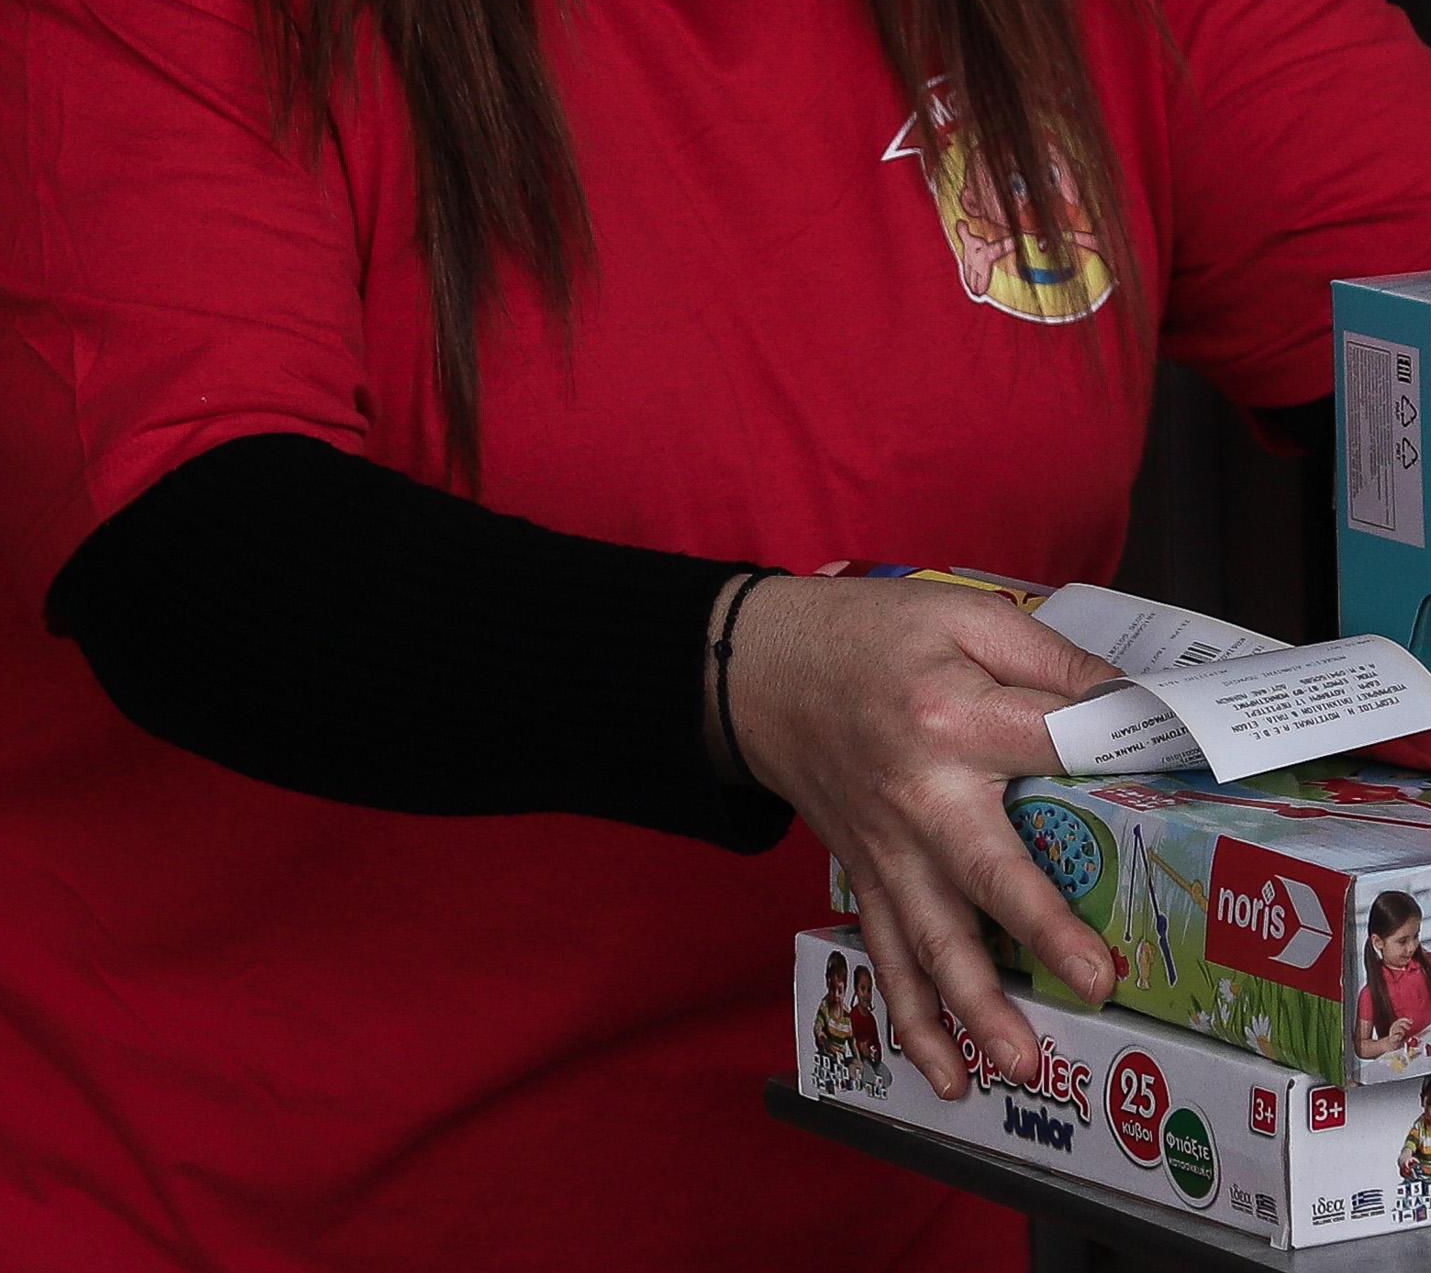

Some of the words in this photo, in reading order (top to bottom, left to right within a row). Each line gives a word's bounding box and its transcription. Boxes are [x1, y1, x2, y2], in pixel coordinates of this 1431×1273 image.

[1094, 752, 1114, 764] YOU
[1114, 741, 1144, 757] THANK
[1217, 881, 1288, 940] noris
[1119, 1067, 1158, 1119] 25
[1254, 1097, 1275, 1125] 3+
[1314, 1098, 1344, 1121] 3+
[1003, 1097, 1074, 1152] Junior
[1121, 1120, 1154, 1144] κύβοι
[1165, 1130, 1212, 1161] Φτιάξτε
